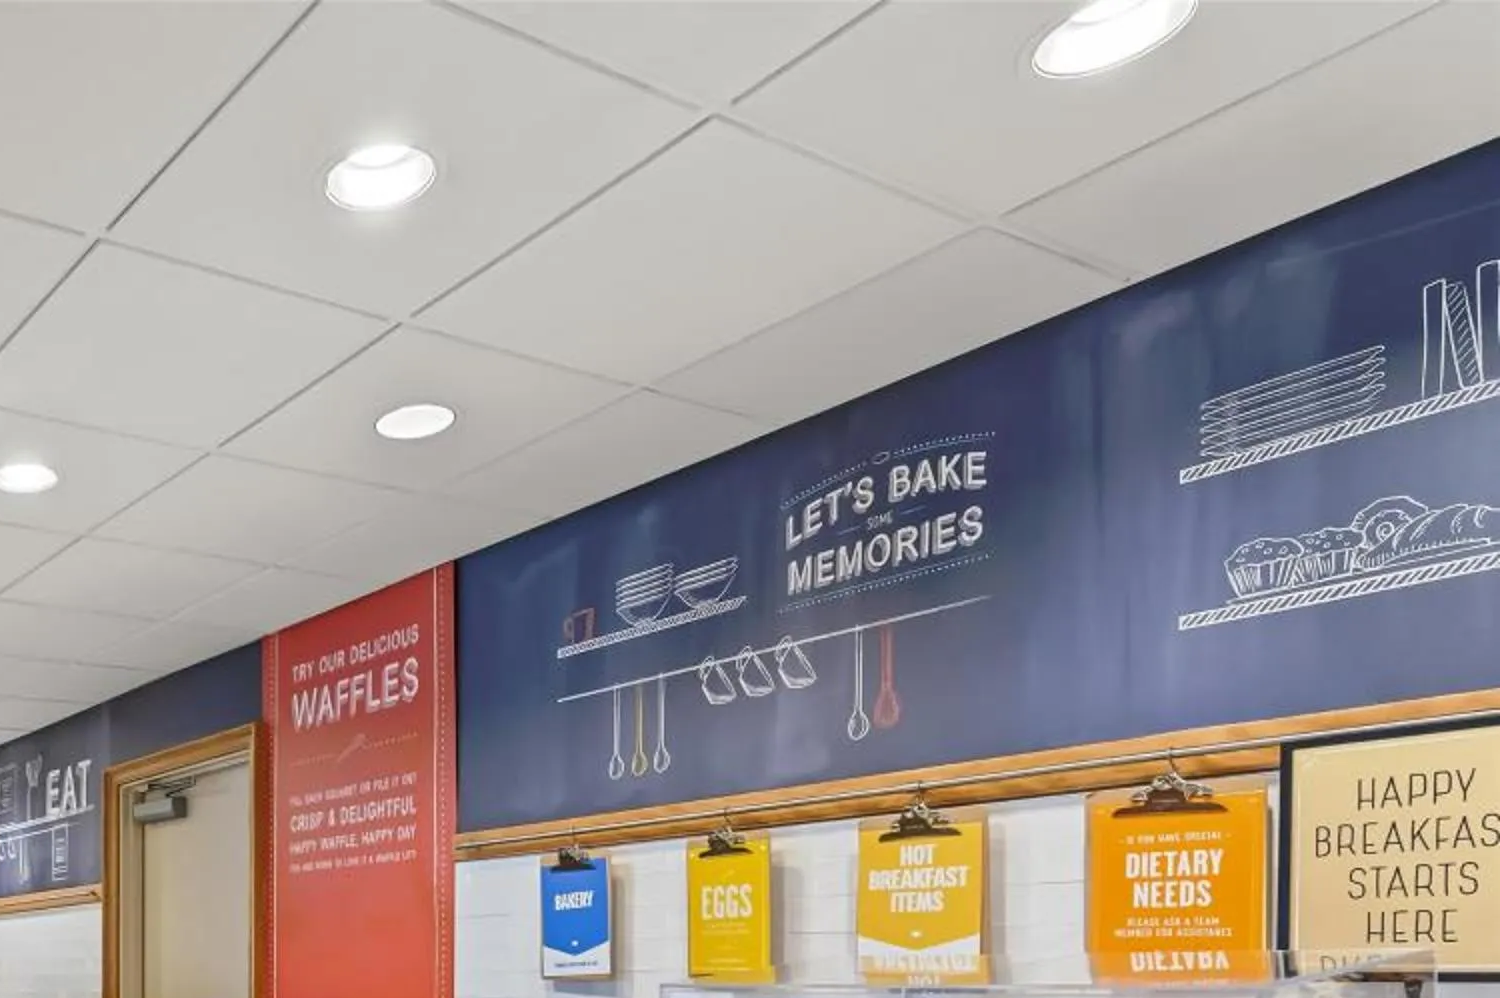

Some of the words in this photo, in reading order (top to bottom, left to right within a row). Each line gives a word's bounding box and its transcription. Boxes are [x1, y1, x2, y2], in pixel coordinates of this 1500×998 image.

[785, 477, 874, 550] LET'S
[888, 451, 988, 503] BAKE
[867, 511, 894, 531] SOME
[787, 505, 984, 596] MEMORIES
[292, 660, 315, 682] TRY
[319, 649, 345, 674] OUR
[349, 623, 419, 665] DELICIOUS
[291, 656, 419, 732] WAFFLES
[46, 759, 92, 818] EAT
[1357, 767, 1477, 812] HAPPY
[290, 811, 324, 833] CRISP
[339, 795, 417, 827] DELIGHTFUL
[360, 829, 394, 846] HAPPY
[397, 823, 417, 842] DAY
[1315, 813, 1500, 858] BREAKFAS
[900, 843, 936, 867] HOT
[1125, 848, 1224, 879] DIETARY
[868, 865, 969, 891] BREAKFAST
[1133, 879, 1212, 909] NEEDS
[1347, 861, 1479, 900] STARTS
[555, 890, 594, 911] BAKERY
[702, 883, 753, 920] EGGS
[890, 890, 945, 913] ITEMS
[1366, 909, 1459, 944] HERE
